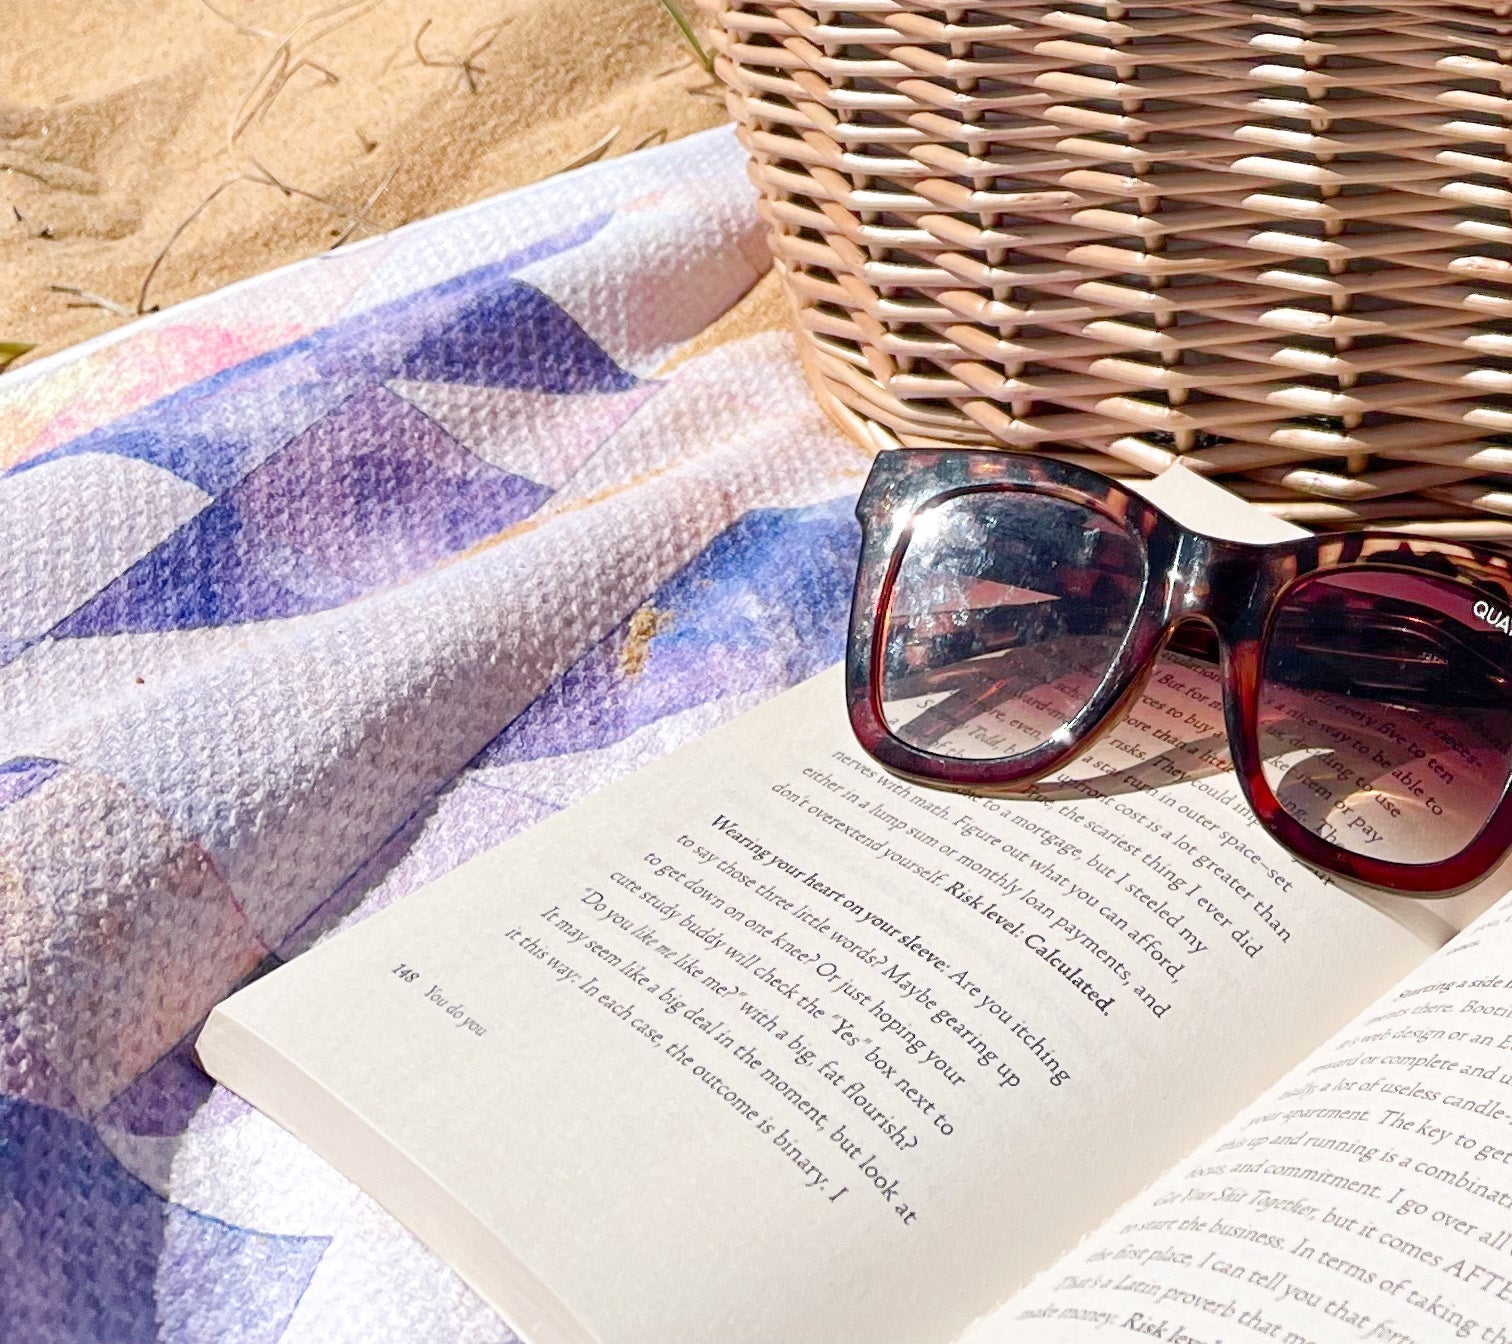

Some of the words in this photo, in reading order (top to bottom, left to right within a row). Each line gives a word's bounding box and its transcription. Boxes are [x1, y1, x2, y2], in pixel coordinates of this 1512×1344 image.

[1391, 769, 1425, 796] able
[1425, 795, 1443, 816] to
[1427, 757, 1454, 785] ten
[1333, 798, 1354, 816] or
[1350, 814, 1384, 844] pay
[1374, 793, 1401, 818] use
[802, 767, 844, 792] either
[840, 790, 860, 804] in
[868, 803, 908, 831] lump
[905, 827, 939, 847] sum
[938, 845, 958, 857] or
[955, 854, 1023, 896] monthly
[1019, 888, 1055, 919] loan
[1048, 916, 1131, 986] payments,
[1133, 985, 1172, 1019] and
[807, 806, 889, 851] overextend
[876, 848, 949, 886] yourself.
[943, 880, 984, 910] Risk
[980, 903, 1025, 938] level:
[1024, 934, 1116, 1016] Calculated.
[643, 852, 662, 866] to
[653, 865, 686, 882] get
[683, 878, 725, 909] down
[723, 906, 745, 922] on
[744, 919, 773, 938] one
[770, 931, 821, 964] knee?
[815, 962, 841, 983] Or
[831, 979, 872, 1006] just
[867, 999, 927, 1055] hoping
[917, 1049, 966, 1086] your
[676, 834, 695, 847] to
[692, 846, 719, 864] say
[716, 860, 757, 887] those
[754, 884, 794, 911] three
[791, 904, 831, 933] little
[830, 931, 888, 967] words?
[880, 963, 937, 1010] Maybe
[929, 1009, 999, 1066] gearing
[996, 1062, 1020, 1088] up
[711, 813, 772, 861] Wearing
[762, 855, 806, 879] your
[801, 872, 845, 902] heart
[842, 899, 864, 915] on
[856, 911, 902, 937] your
[897, 934, 950, 973] sleeve:
[947, 970, 981, 997] Are
[973, 994, 1013, 1024] you
[1010, 1021, 1071, 1087] itching
[391, 963, 420, 983] 148
[423, 984, 449, 1007] You
[445, 1004, 464, 1019] do
[455, 1016, 487, 1037] you
[1467, 974, 1504, 988] side
[504, 926, 522, 940] it
[518, 937, 549, 959] this
[546, 956, 582, 983] way:
[578, 976, 599, 997] In
[597, 994, 635, 1021] each
[630, 1018, 664, 1048] case,
[665, 1043, 694, 1066] the
[692, 1065, 759, 1120] outcome
[755, 1116, 775, 1134] is
[772, 1128, 829, 1191] binary.
[1380, 1053, 1459, 1071] complete
[1459, 1064, 1501, 1080] and
[1380, 1081, 1441, 1101] useless
[1377, 1109, 1415, 1131] The
[1414, 1118, 1453, 1146] key
[1454, 1133, 1477, 1150] to
